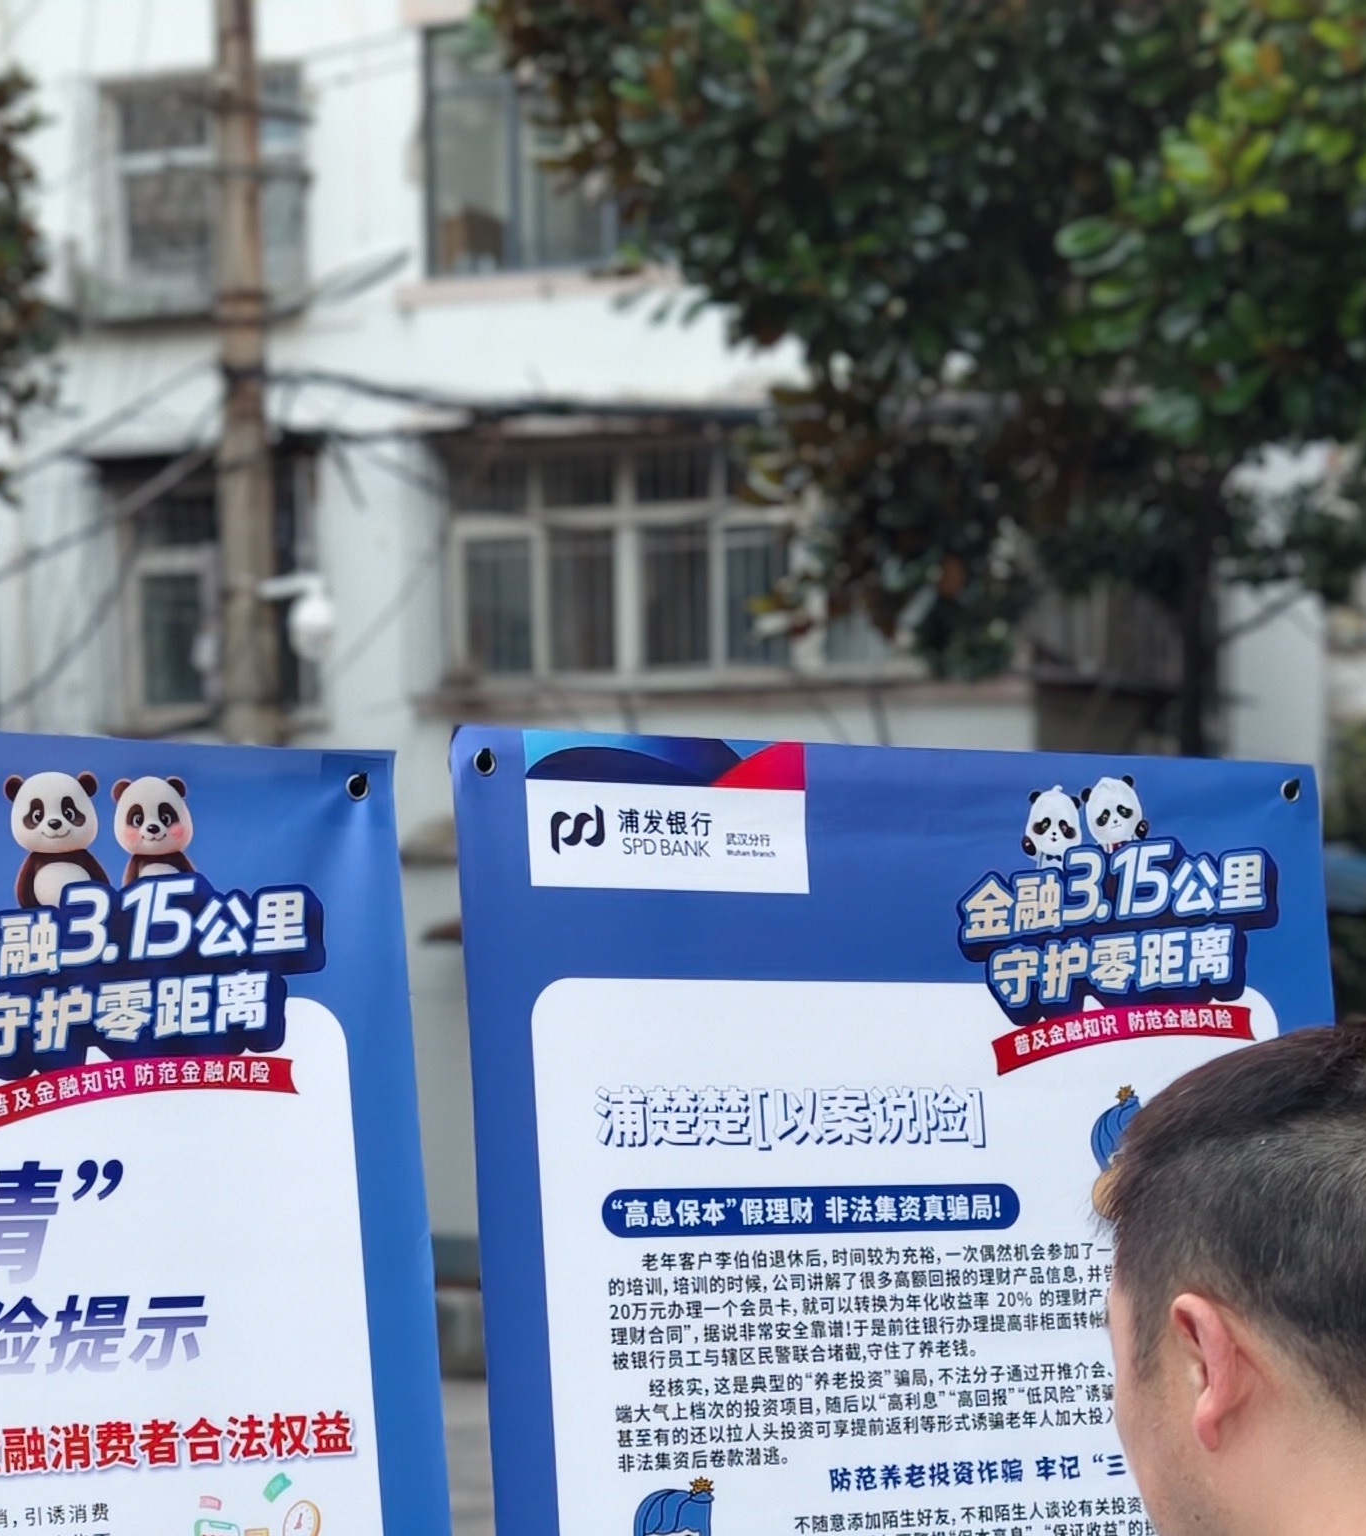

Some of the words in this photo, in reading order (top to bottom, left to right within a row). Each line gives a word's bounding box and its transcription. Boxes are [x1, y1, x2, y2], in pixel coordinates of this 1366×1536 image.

[618, 807, 713, 837] 浦发银行
[622, 837, 657, 855] SPD
[660, 838, 711, 858] BANK
[725, 833, 771, 847] 武汉分行
[961, 842, 1267, 942] 金融3.15公里
[991, 924, 1235, 1006] 守护零距离
[1013, 1013, 1119, 1056] 普及金融知识
[1127, 1008, 1233, 1032] 防范金融风险
[134, 1060, 271, 1087] 防范金融风险
[611, 1195, 814, 1229] “高息保本”假理财
[996, 1291, 1032, 1308] 20%
[1039, 1287, 1111, 1308] 的理财产
[828, 1458, 1024, 1493] 防范养老投资诈骗
[1035, 1455, 1082, 1483] 牢记
